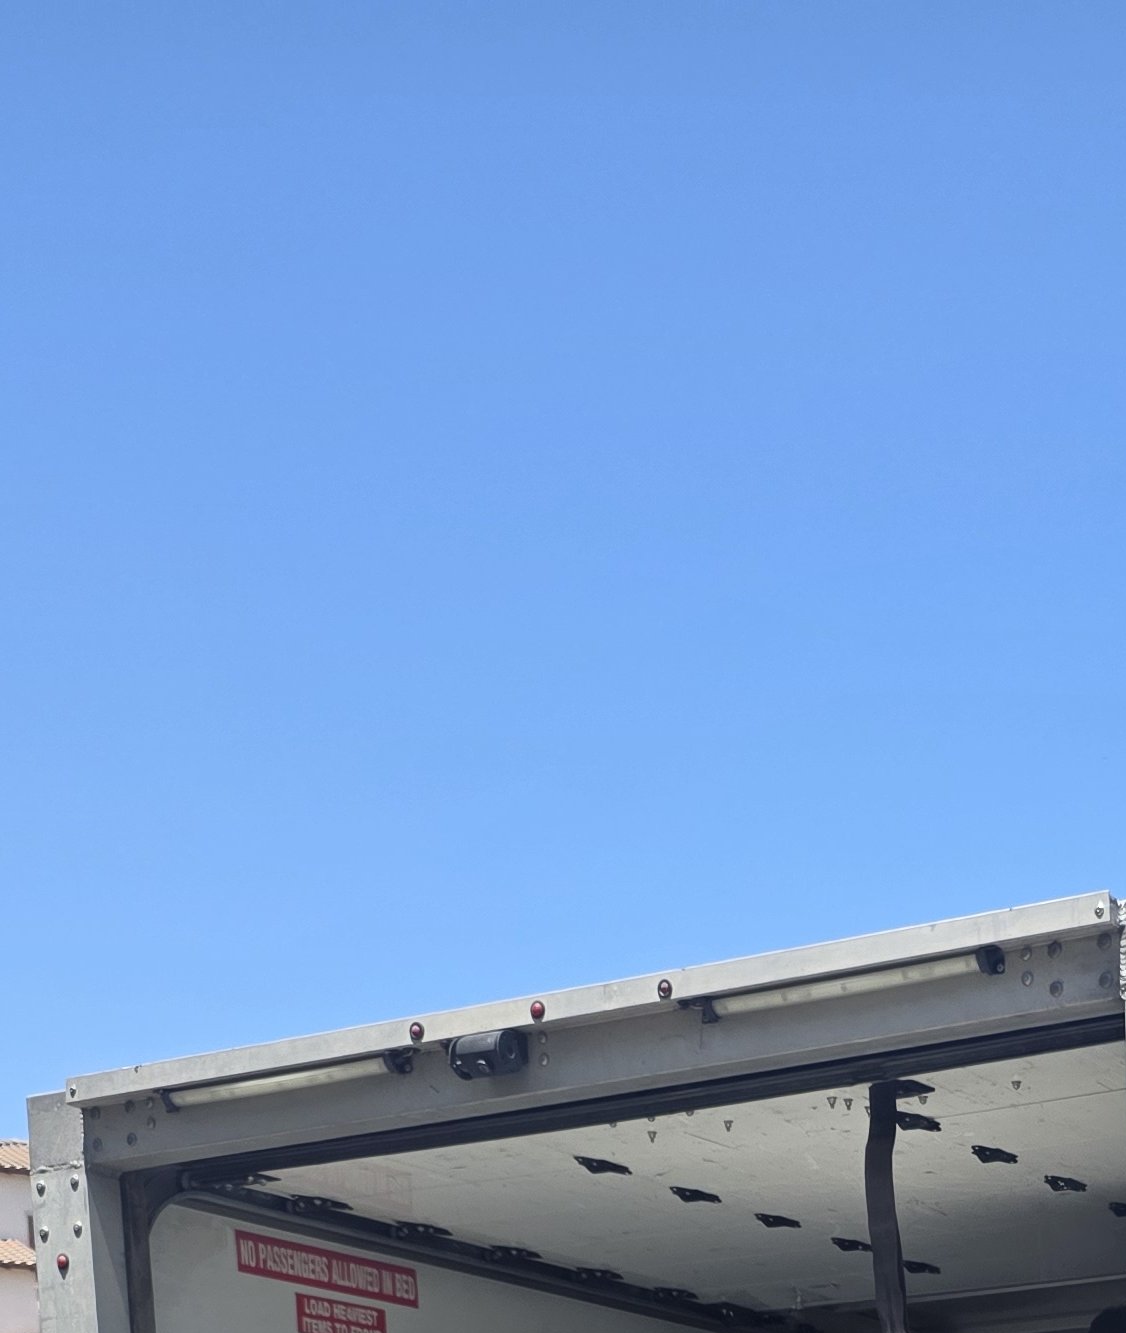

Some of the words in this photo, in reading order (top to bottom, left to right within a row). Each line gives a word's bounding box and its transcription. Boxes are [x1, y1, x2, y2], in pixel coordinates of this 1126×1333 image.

[240, 1239, 257, 1268] NO
[259, 1243, 329, 1284] PASSENGERS
[331, 1259, 380, 1294] ALLOWED
[381, 1270, 393, 1297] IN
[395, 1273, 416, 1301] BED
[303, 1297, 330, 1318] LOAD
[333, 1303, 378, 1327] HEAVIEST
